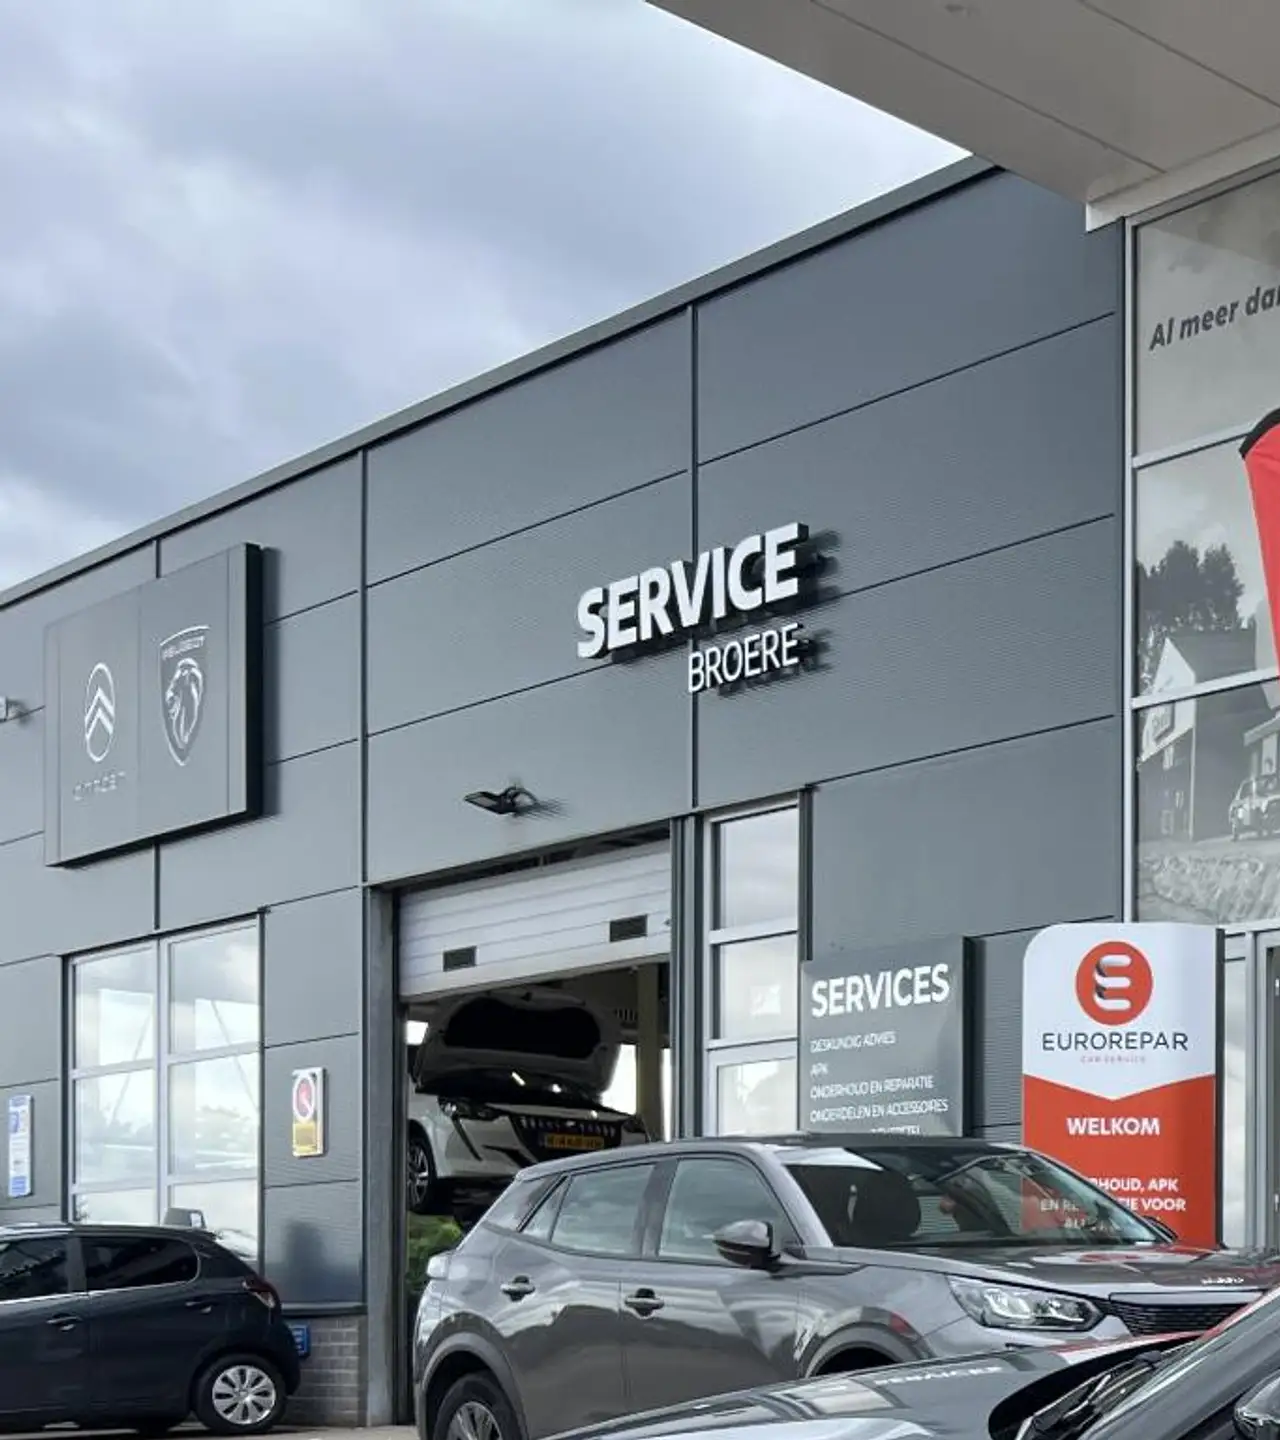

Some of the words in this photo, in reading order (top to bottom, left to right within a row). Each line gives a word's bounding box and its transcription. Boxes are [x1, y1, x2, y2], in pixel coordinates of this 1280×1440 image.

[1149, 317, 1174, 351] Al
[1179, 300, 1240, 341] meer
[576, 521, 800, 659] SERVICE
[687, 621, 800, 693] BROERE
[811, 963, 950, 1018] SERVICES
[1042, 1031, 1189, 1051] EUROREPAR
[870, 1080, 883, 1095] EN
[872, 1103, 884, 1118] EN
[1066, 1117, 1161, 1136] WELKOM
[1147, 1177, 1179, 1192] APK
[1141, 1197, 1187, 1212] VOOR
